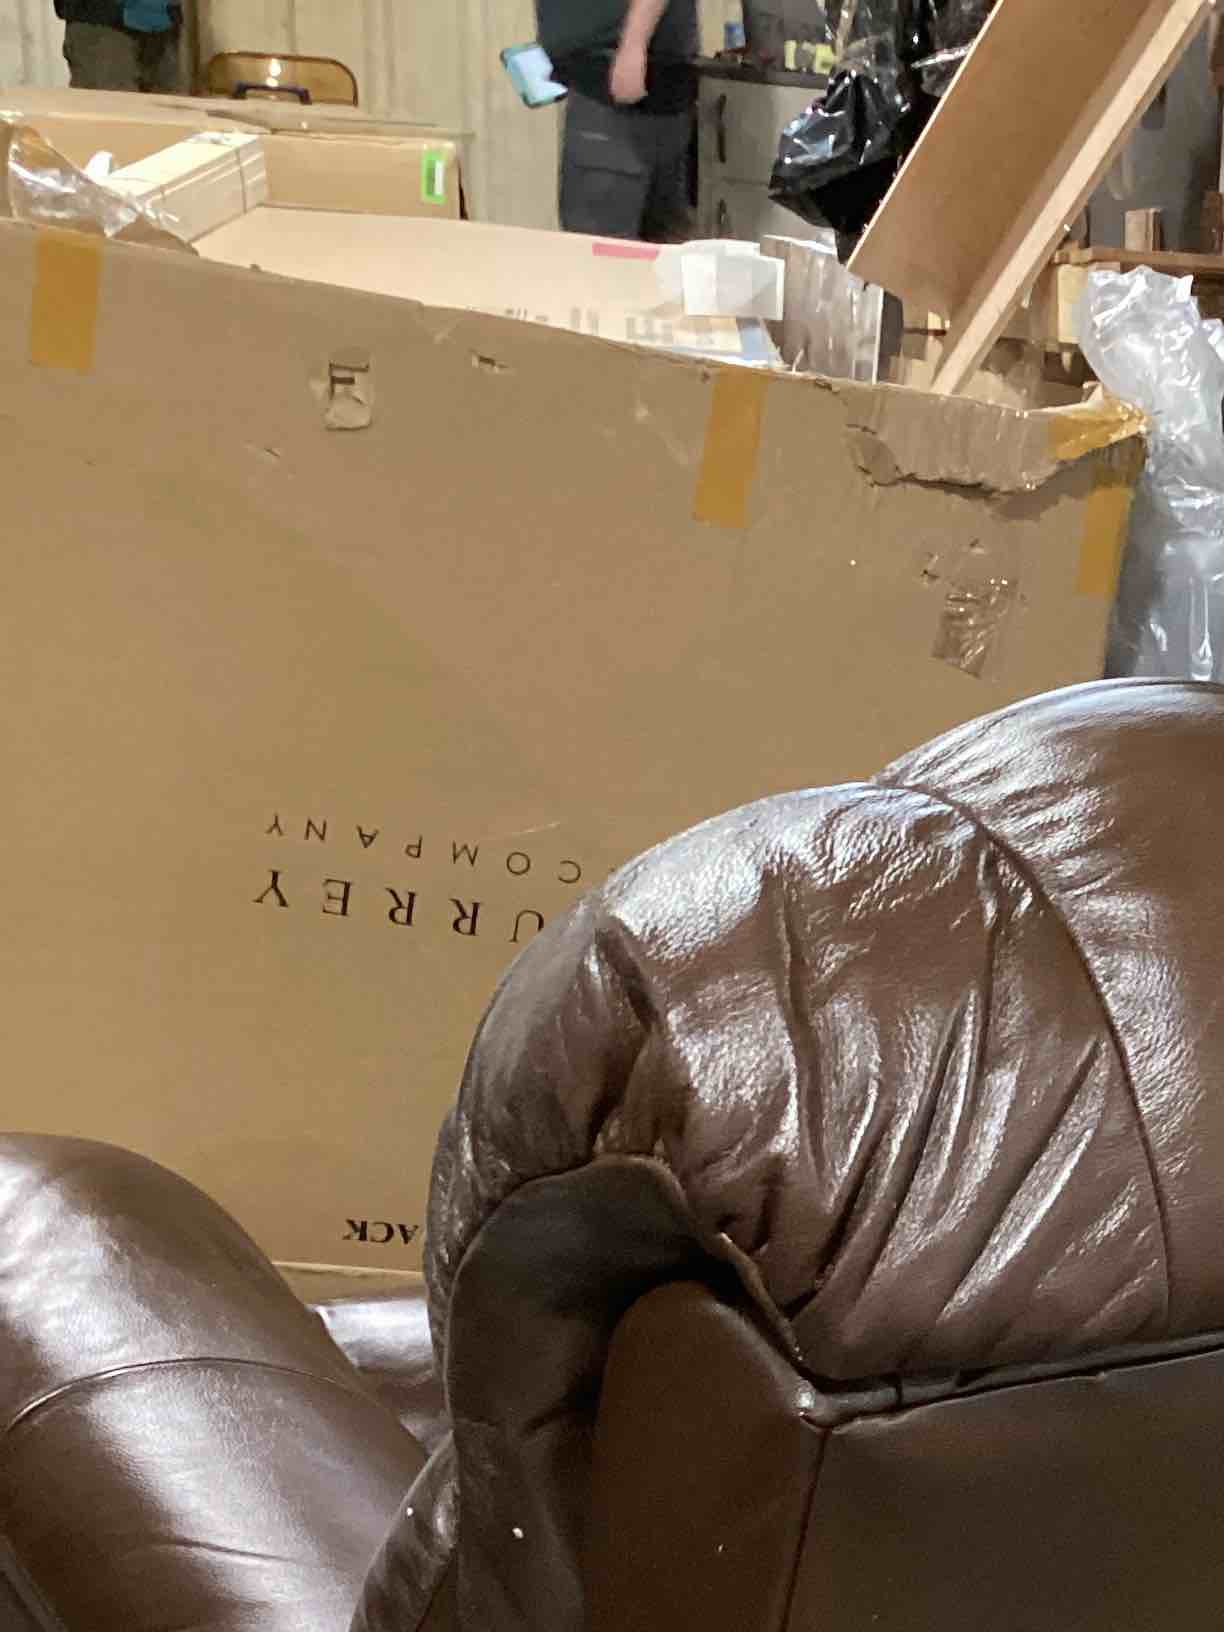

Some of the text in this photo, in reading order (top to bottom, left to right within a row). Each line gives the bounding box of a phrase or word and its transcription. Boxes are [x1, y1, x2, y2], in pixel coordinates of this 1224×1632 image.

[266, 813, 582, 884] COMPANY
[252, 869, 545, 943] URREY
[341, 1218, 420, 1245] ACK
